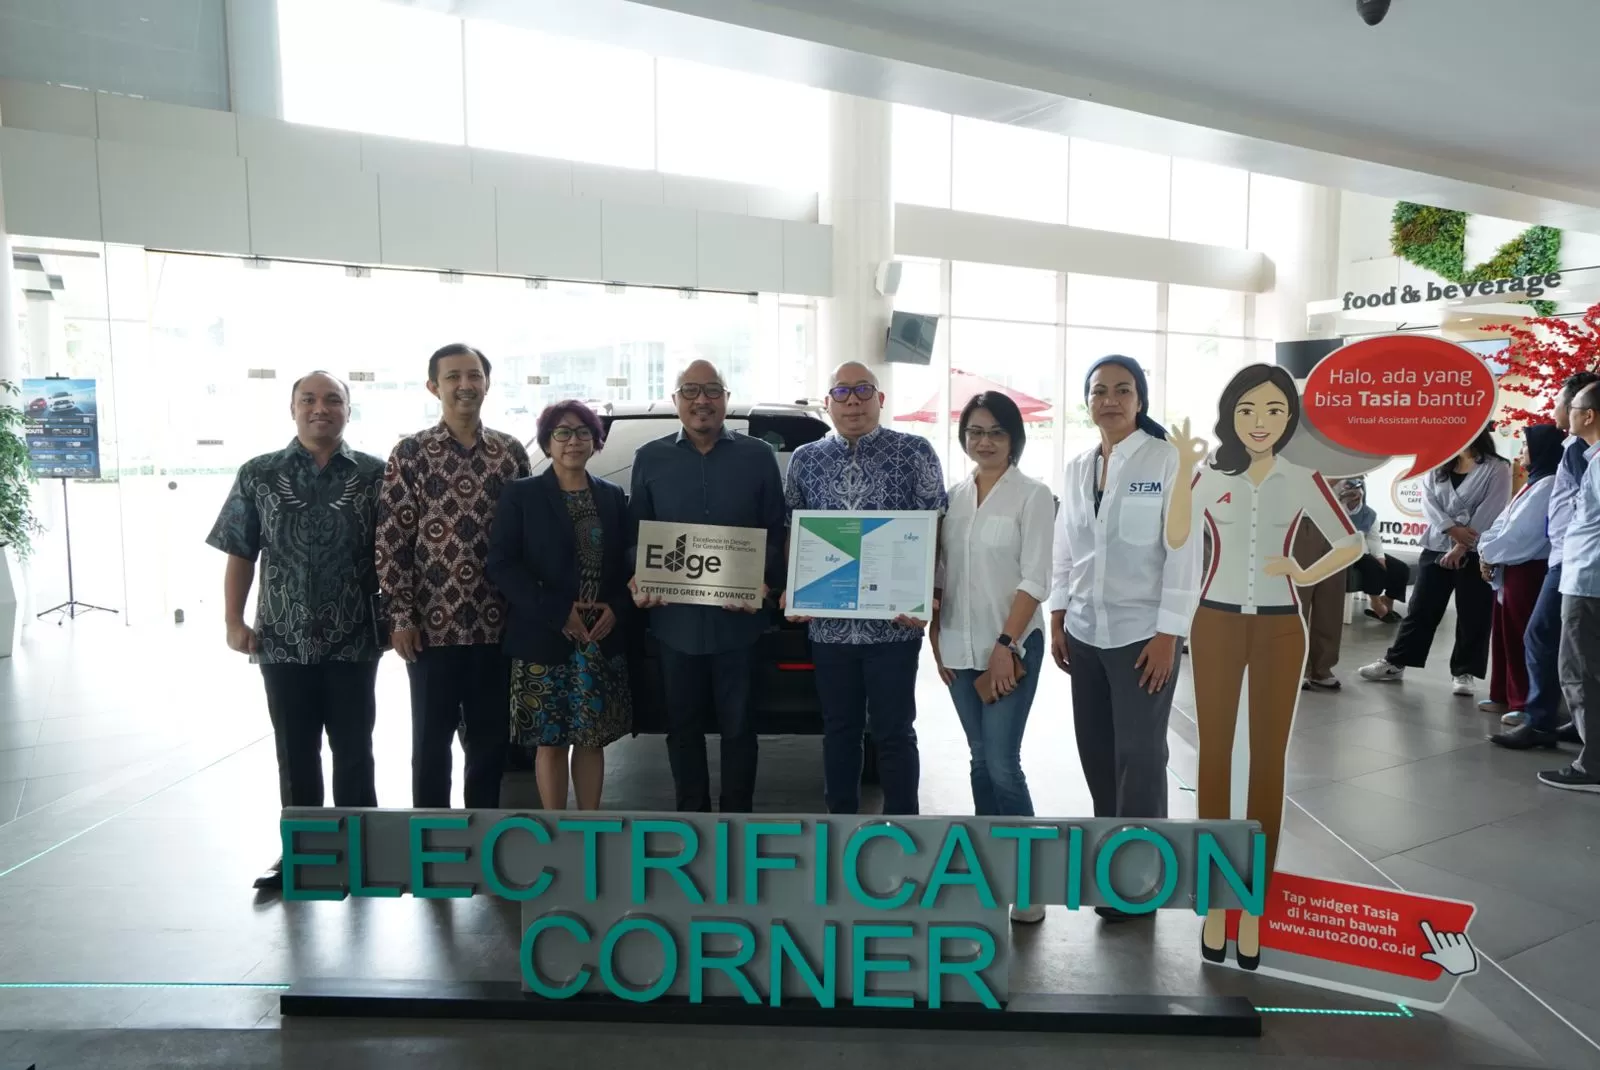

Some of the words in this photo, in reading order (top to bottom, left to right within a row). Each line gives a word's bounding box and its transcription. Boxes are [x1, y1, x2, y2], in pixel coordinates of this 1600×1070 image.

[1342, 286, 1398, 311] food
[1400, 285, 1422, 304] &
[1425, 271, 1562, 302] beverage
[1329, 368, 1376, 386] Halo,
[1382, 368, 1417, 385] ada
[1423, 370, 1473, 387] yang
[1315, 391, 1352, 407] bisa
[1358, 390, 1411, 407] Tasia
[1418, 390, 1486, 407] bantu?
[1347, 415, 1377, 425] Virtual
[1378, 415, 1418, 425] Assistant
[1421, 415, 1467, 425] Auto2000
[1129, 481, 1162, 492] STEM
[645, 533, 722, 579] Edge
[640, 586, 679, 596] CERTIFIED
[680, 588, 706, 598] GREEN
[713, 591, 756, 601] ADVANCED
[280, 813, 1267, 917] ELECTRIFICATION
[1282, 890, 1307, 905] Tap
[1309, 896, 1359, 915] widget
[1362, 904, 1400, 922] Tasia
[1286, 906, 1301, 919] di
[1303, 909, 1346, 929] kanan
[1348, 916, 1398, 938] bawah
[1268, 919, 1417, 957] www.auto2000.co.id
[519, 910, 1004, 1011] CORNER
